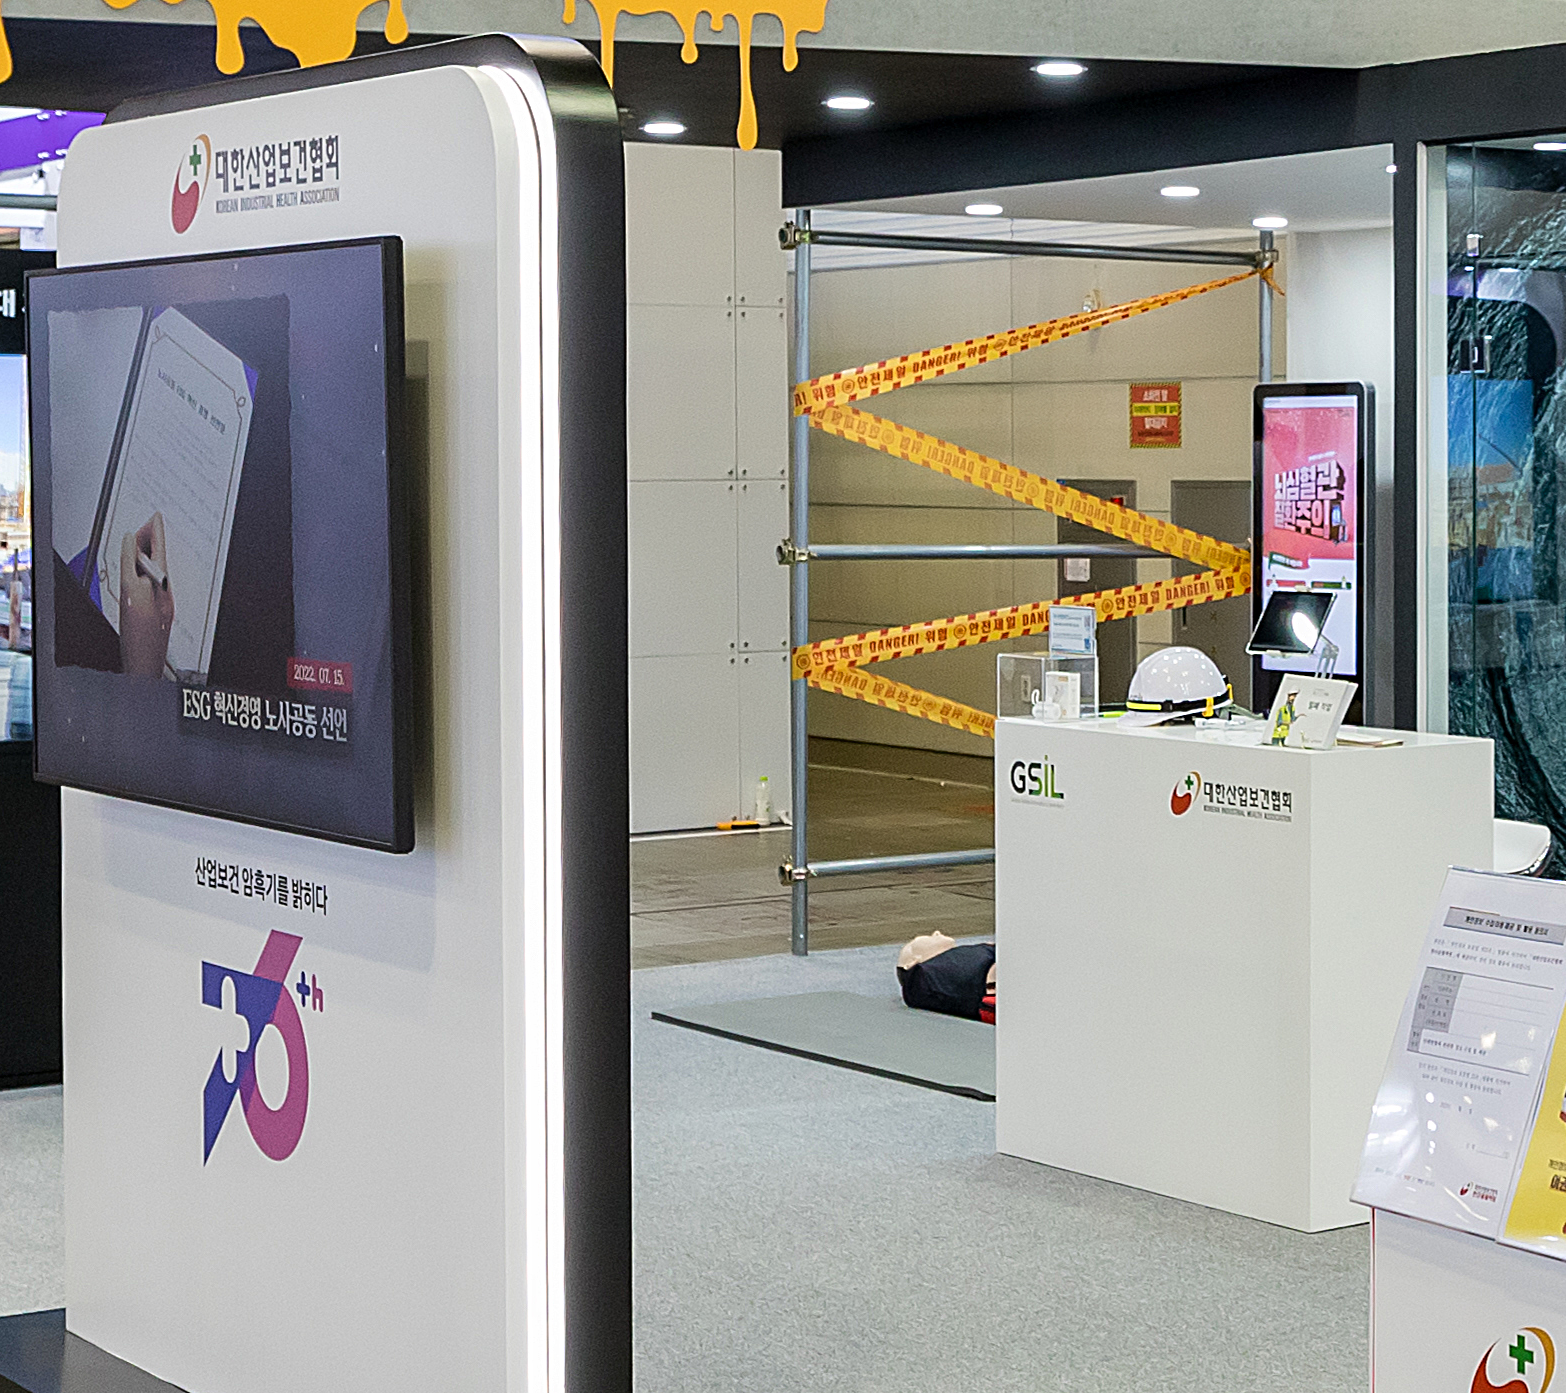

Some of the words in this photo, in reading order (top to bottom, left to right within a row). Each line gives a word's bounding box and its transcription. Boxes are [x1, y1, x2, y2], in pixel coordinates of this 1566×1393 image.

[215, 134, 341, 194] 대한산업보건협회
[215, 198, 239, 215] KOREAN
[240, 193, 274, 213] INDUSTRIAL
[276, 190, 299, 208] HEALTH
[300, 186, 340, 207] ASSOCIATION
[812, 384, 836, 403] 위험
[857, 365, 906, 391] 안전제일
[912, 350, 962, 374] DANGER!
[967, 343, 989, 359] 위험
[1115, 588, 1160, 612] 안전제일
[1165, 577, 1211, 601] DANGER!
[1216, 575, 1235, 592] 위험
[812, 642, 864, 667] 안전제일
[869, 634, 920, 654] DANGER!
[925, 626, 948, 644] 위험
[968, 614, 1017, 636] 안전제일
[294, 663, 316, 682] 2022.
[318, 666, 331, 685] 07.
[333, 668, 345, 686] 15.
[182, 688, 211, 720] ESG
[214, 690, 262, 731] 혁신경영
[264, 699, 318, 740] 노사공동
[320, 705, 348, 743] 선언
[1203, 782, 1293, 814] 대한산업보건협회
[194, 857, 240, 895] 산업보건
[241, 867, 290, 908] 암흑기를
[291, 878, 329, 916] 밝히다
